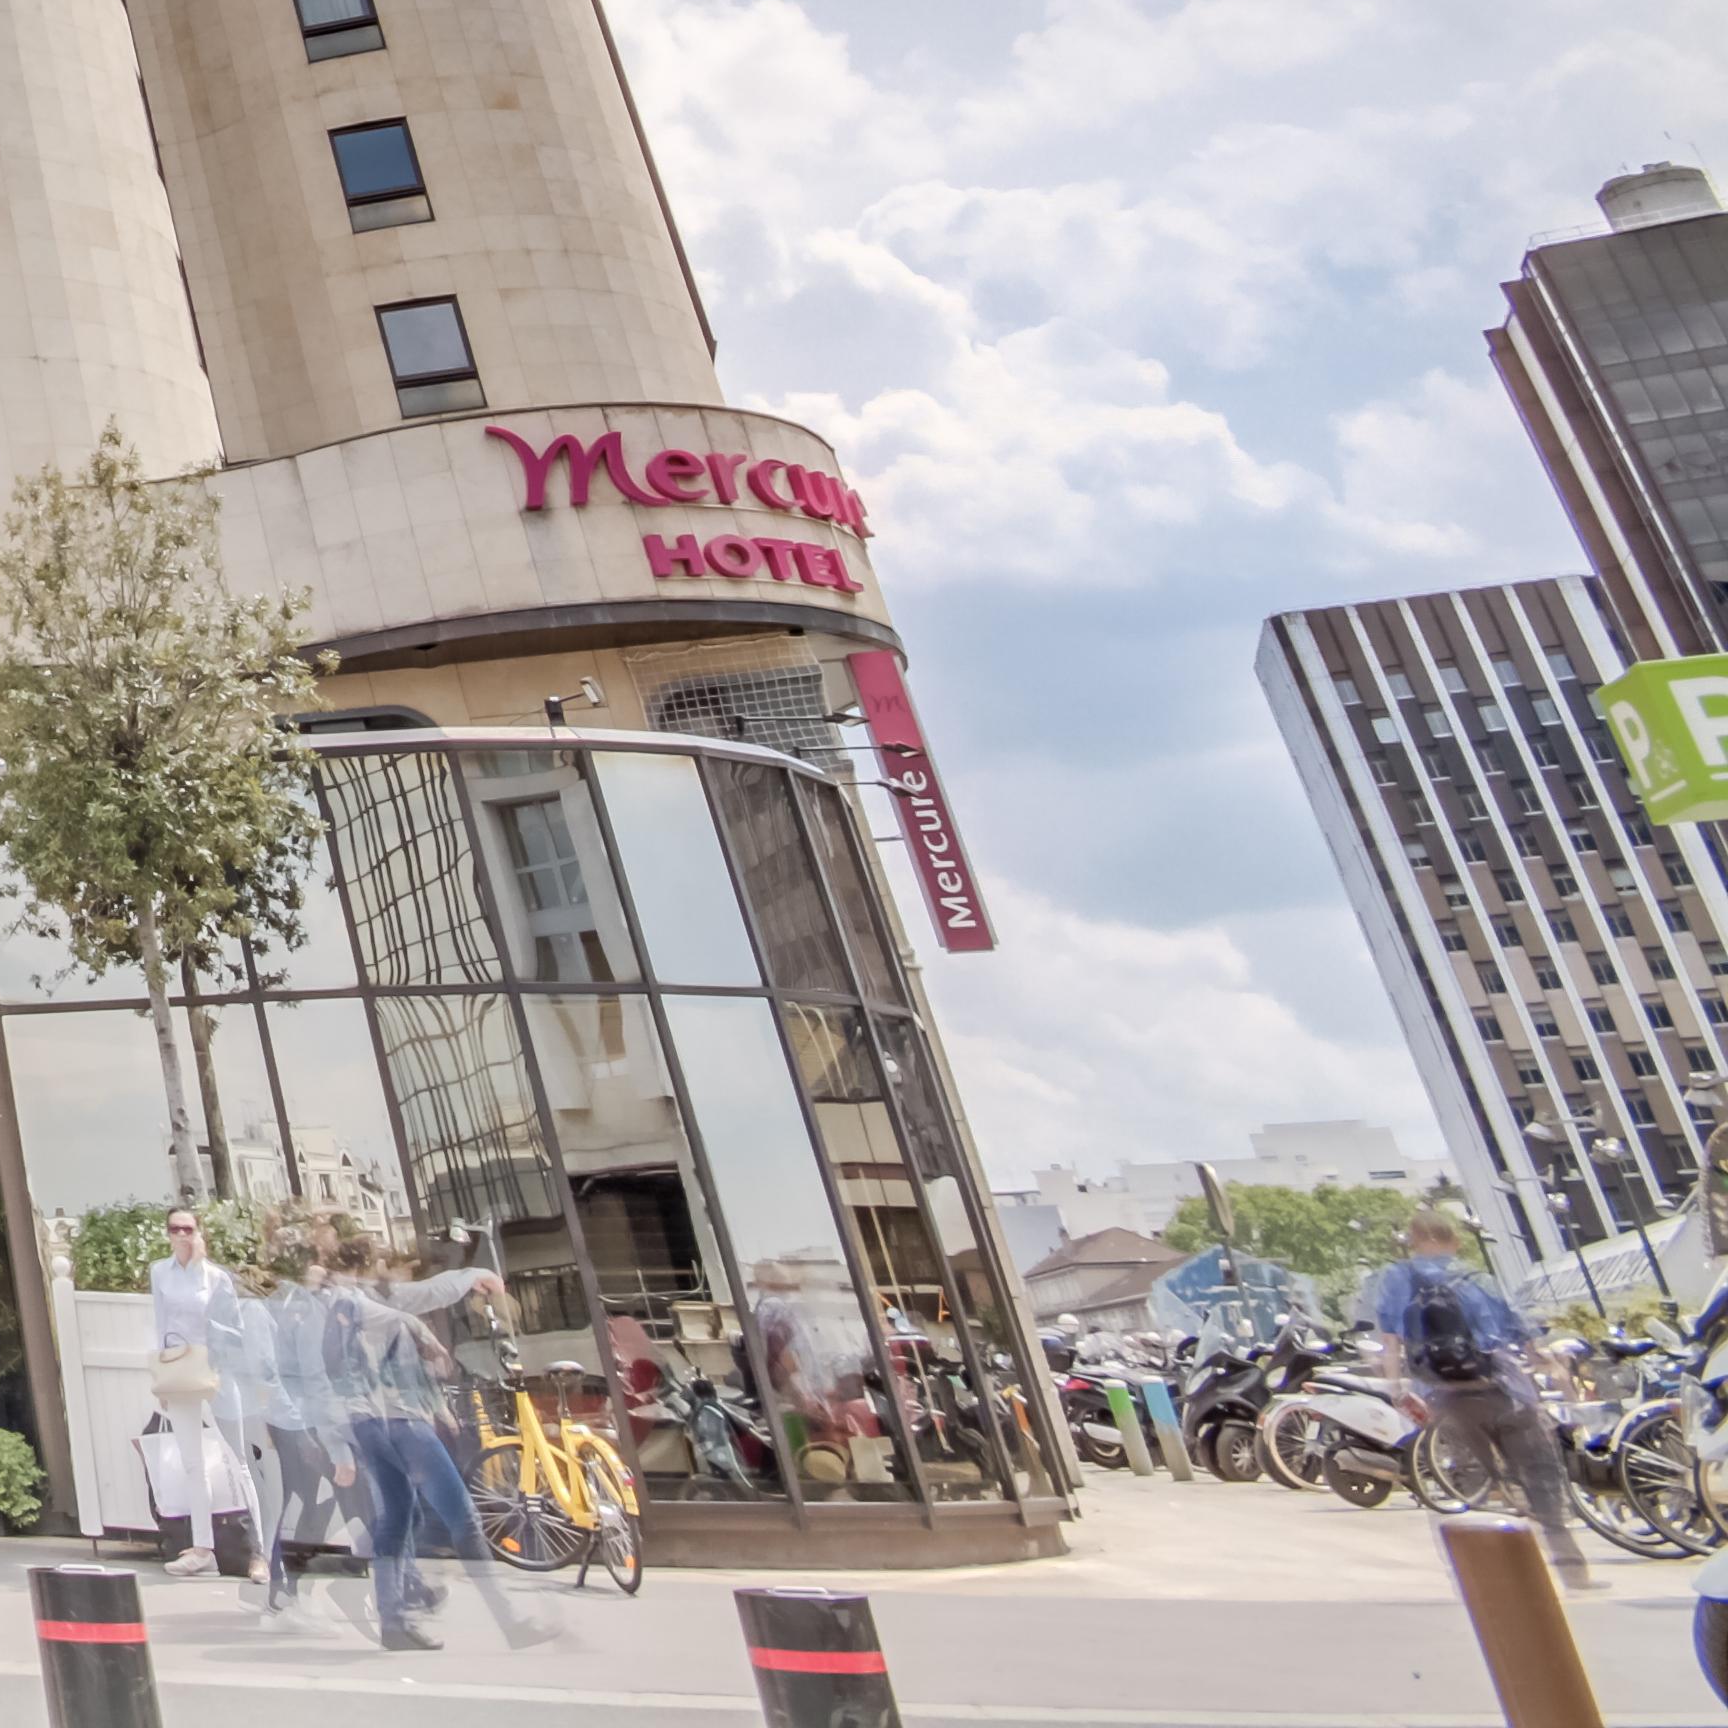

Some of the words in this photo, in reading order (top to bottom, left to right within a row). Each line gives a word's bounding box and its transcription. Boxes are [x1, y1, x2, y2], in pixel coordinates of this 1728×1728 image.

[643, 533, 865, 594] HOTEL
[1610, 700, 1652, 790] P
[902, 769, 977, 929] Mercure
